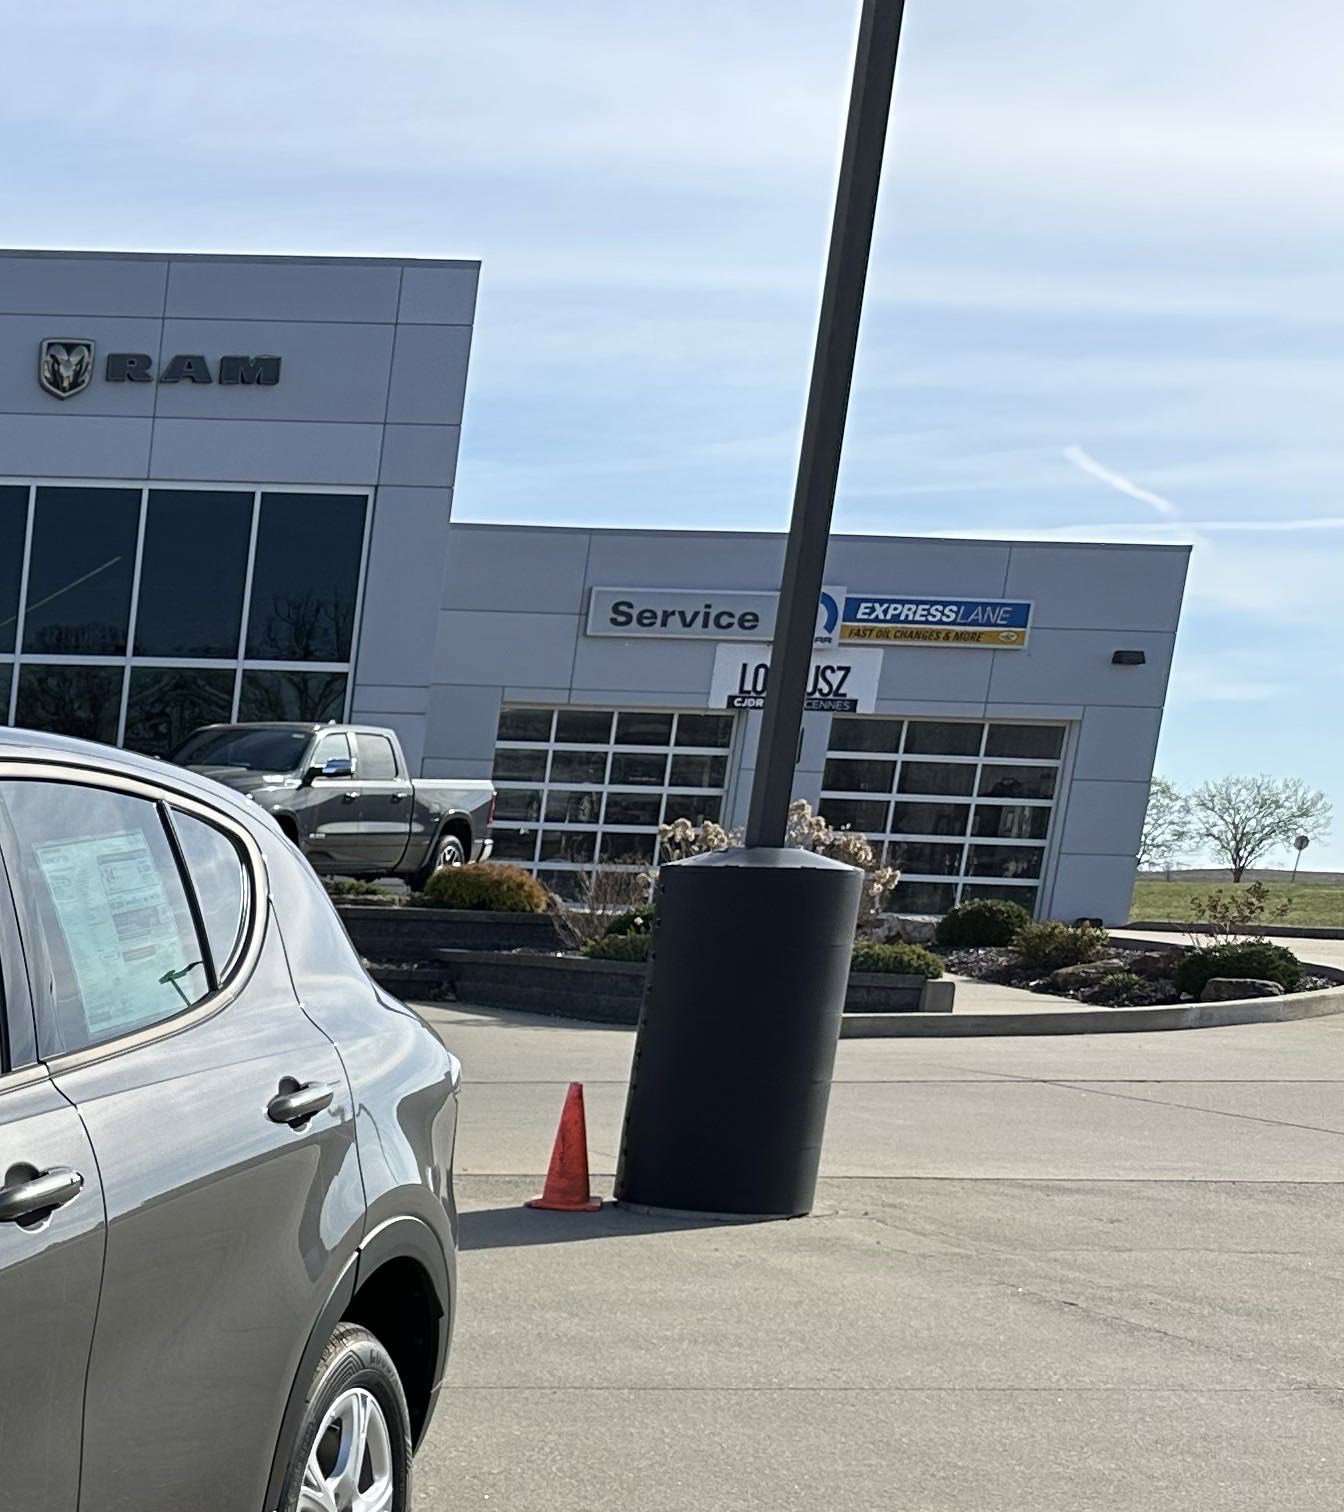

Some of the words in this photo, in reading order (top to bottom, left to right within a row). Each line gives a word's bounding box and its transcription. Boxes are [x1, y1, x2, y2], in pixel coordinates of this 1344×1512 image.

[105, 353, 282, 386] RAM
[609, 600, 760, 631] Service
[847, 627, 875, 639] FAST
[875, 628, 893, 640] OIL
[894, 629, 941, 641] CHANGES
[942, 630, 950, 641] &
[952, 630, 984, 642] MORE
[738, 663, 770, 695] LO
